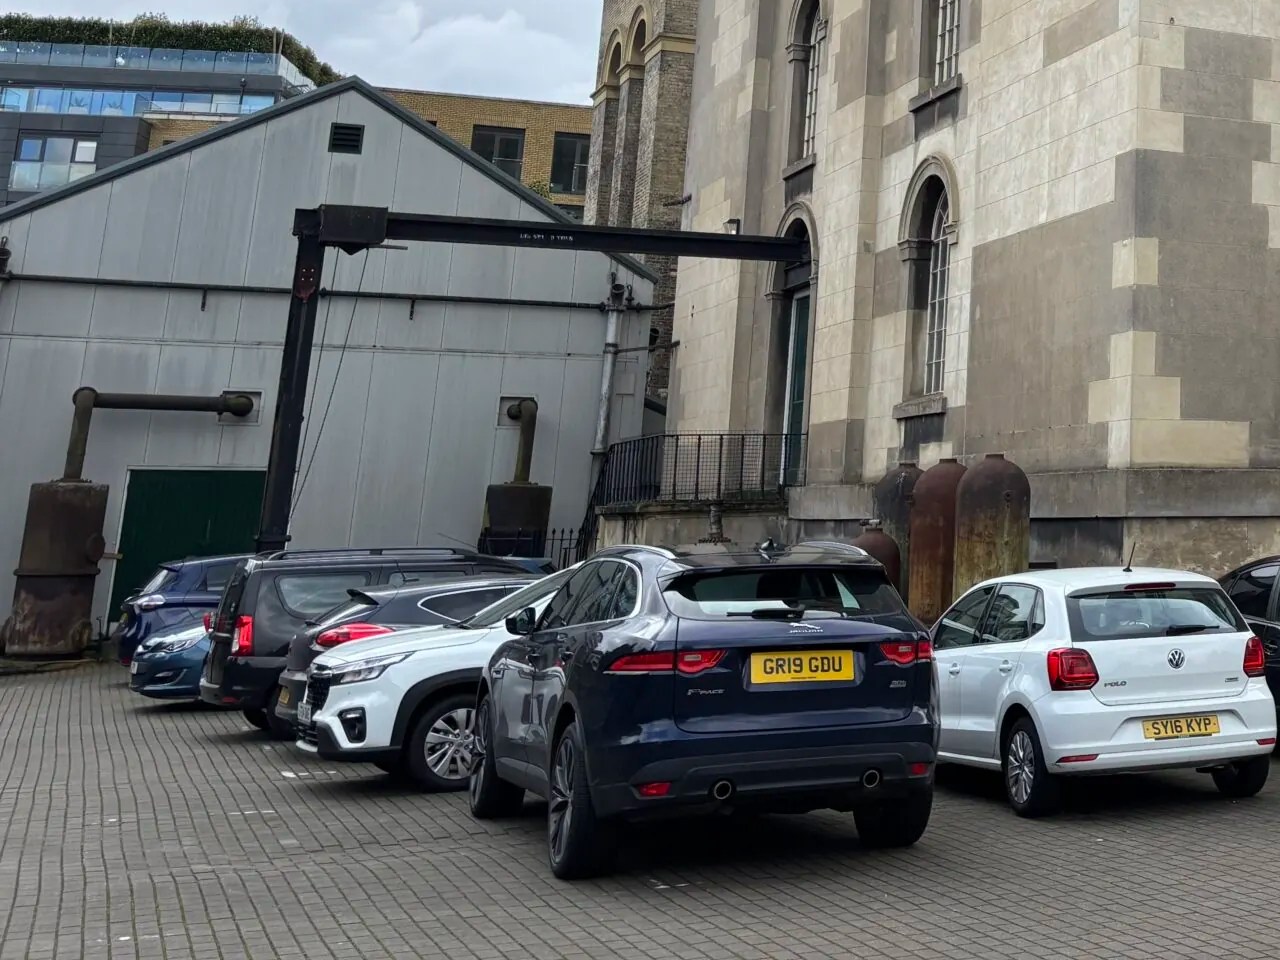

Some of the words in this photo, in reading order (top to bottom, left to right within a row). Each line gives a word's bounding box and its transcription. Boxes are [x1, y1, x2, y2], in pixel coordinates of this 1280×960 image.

[763, 658, 803, 675] GR19
[809, 656, 842, 673] GDU
[1152, 719, 1183, 735] SY16
[1186, 717, 1212, 733] KYP
